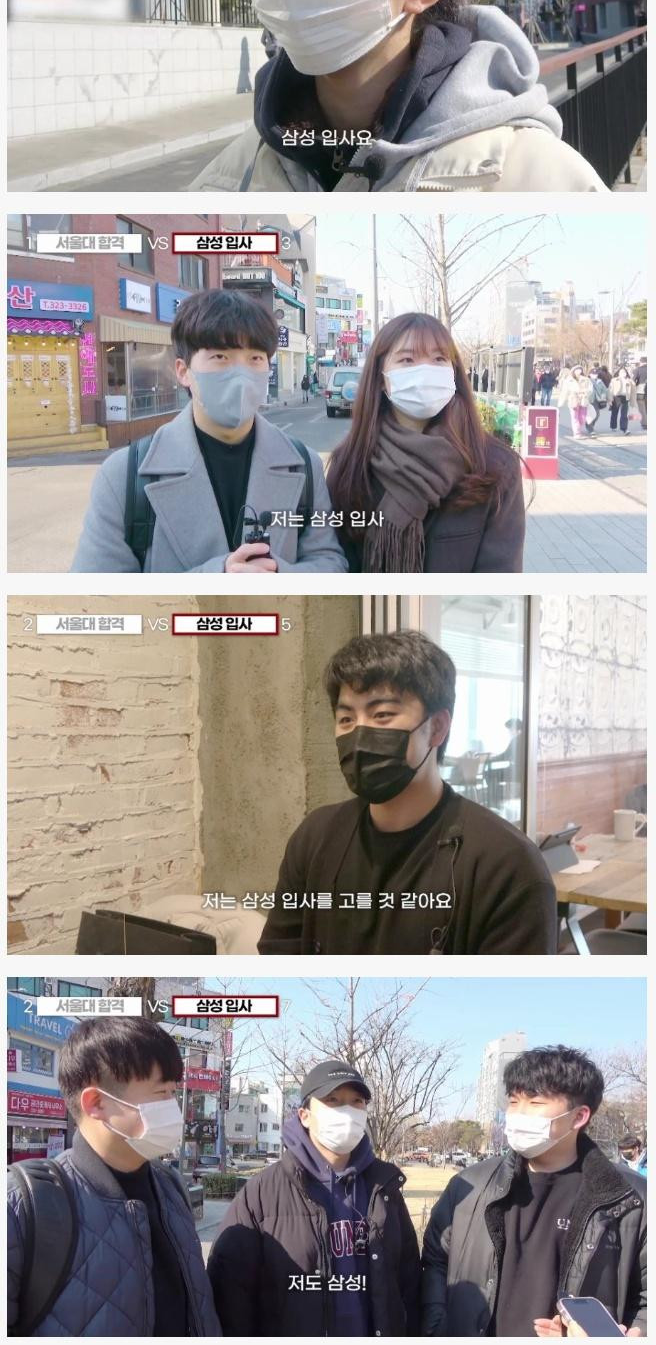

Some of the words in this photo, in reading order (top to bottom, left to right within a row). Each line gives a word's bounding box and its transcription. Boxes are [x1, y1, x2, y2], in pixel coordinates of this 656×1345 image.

[8, 284, 36, 309] 산
[28, 1014, 63, 1035] TRAVEL
[11, 1096, 29, 1111] 다우
